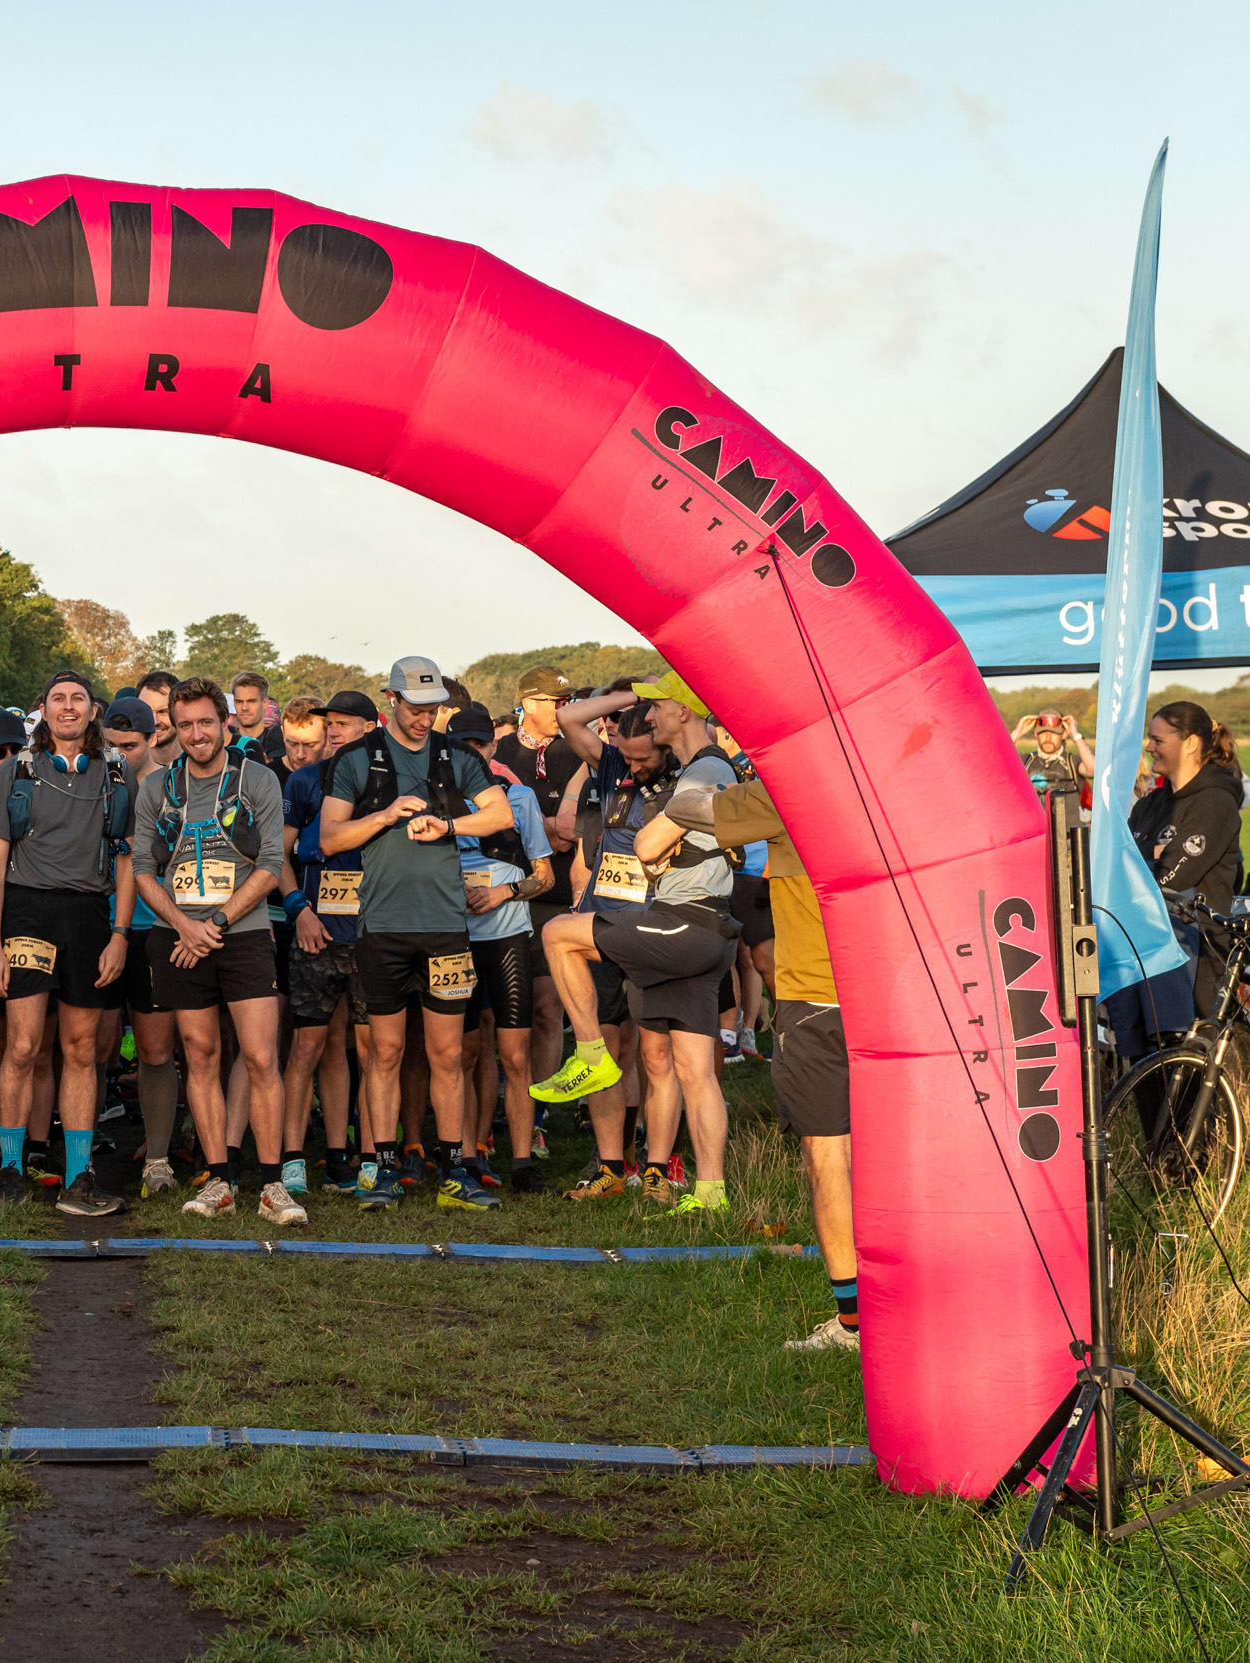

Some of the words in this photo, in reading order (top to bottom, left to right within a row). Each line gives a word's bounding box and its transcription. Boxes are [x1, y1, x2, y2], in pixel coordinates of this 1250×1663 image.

[654, 405, 857, 589] CAMINO
[651, 473, 771, 580] ULTRA
[1059, 582, 1220, 646] god
[598, 868, 622, 884] 296
[320, 887, 349, 901] 297
[9, 953, 29, 967] 40
[431, 972, 459, 987] 252
[447, 988, 469, 997] JOSHUA
[561, 1065, 594, 1094] TERREX
